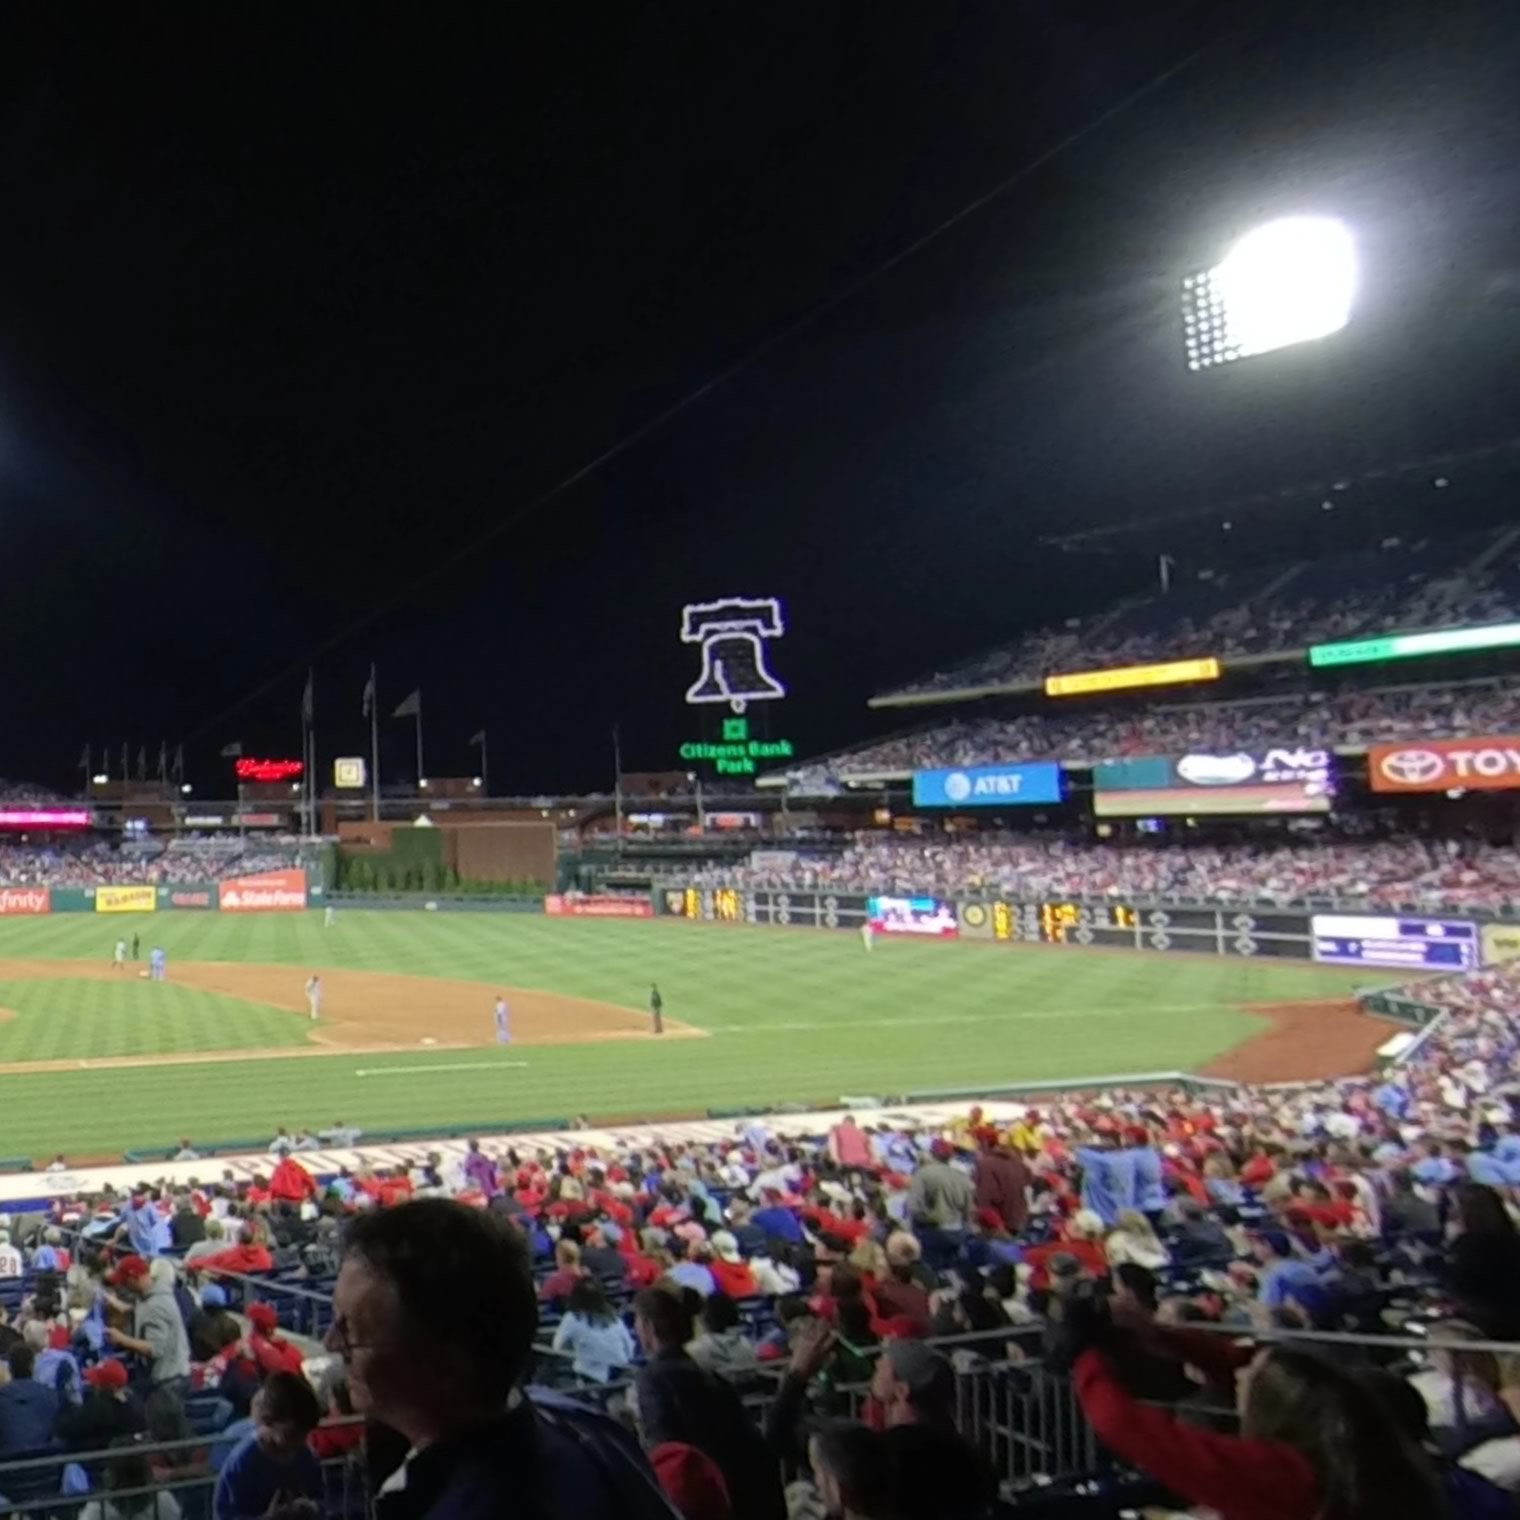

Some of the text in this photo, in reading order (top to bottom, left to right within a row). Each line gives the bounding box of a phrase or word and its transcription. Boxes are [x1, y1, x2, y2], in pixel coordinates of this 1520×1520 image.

[680, 740, 793, 758] Citizens Bank
[716, 757, 754, 774] Park
[974, 774, 1022, 795] AT&T
